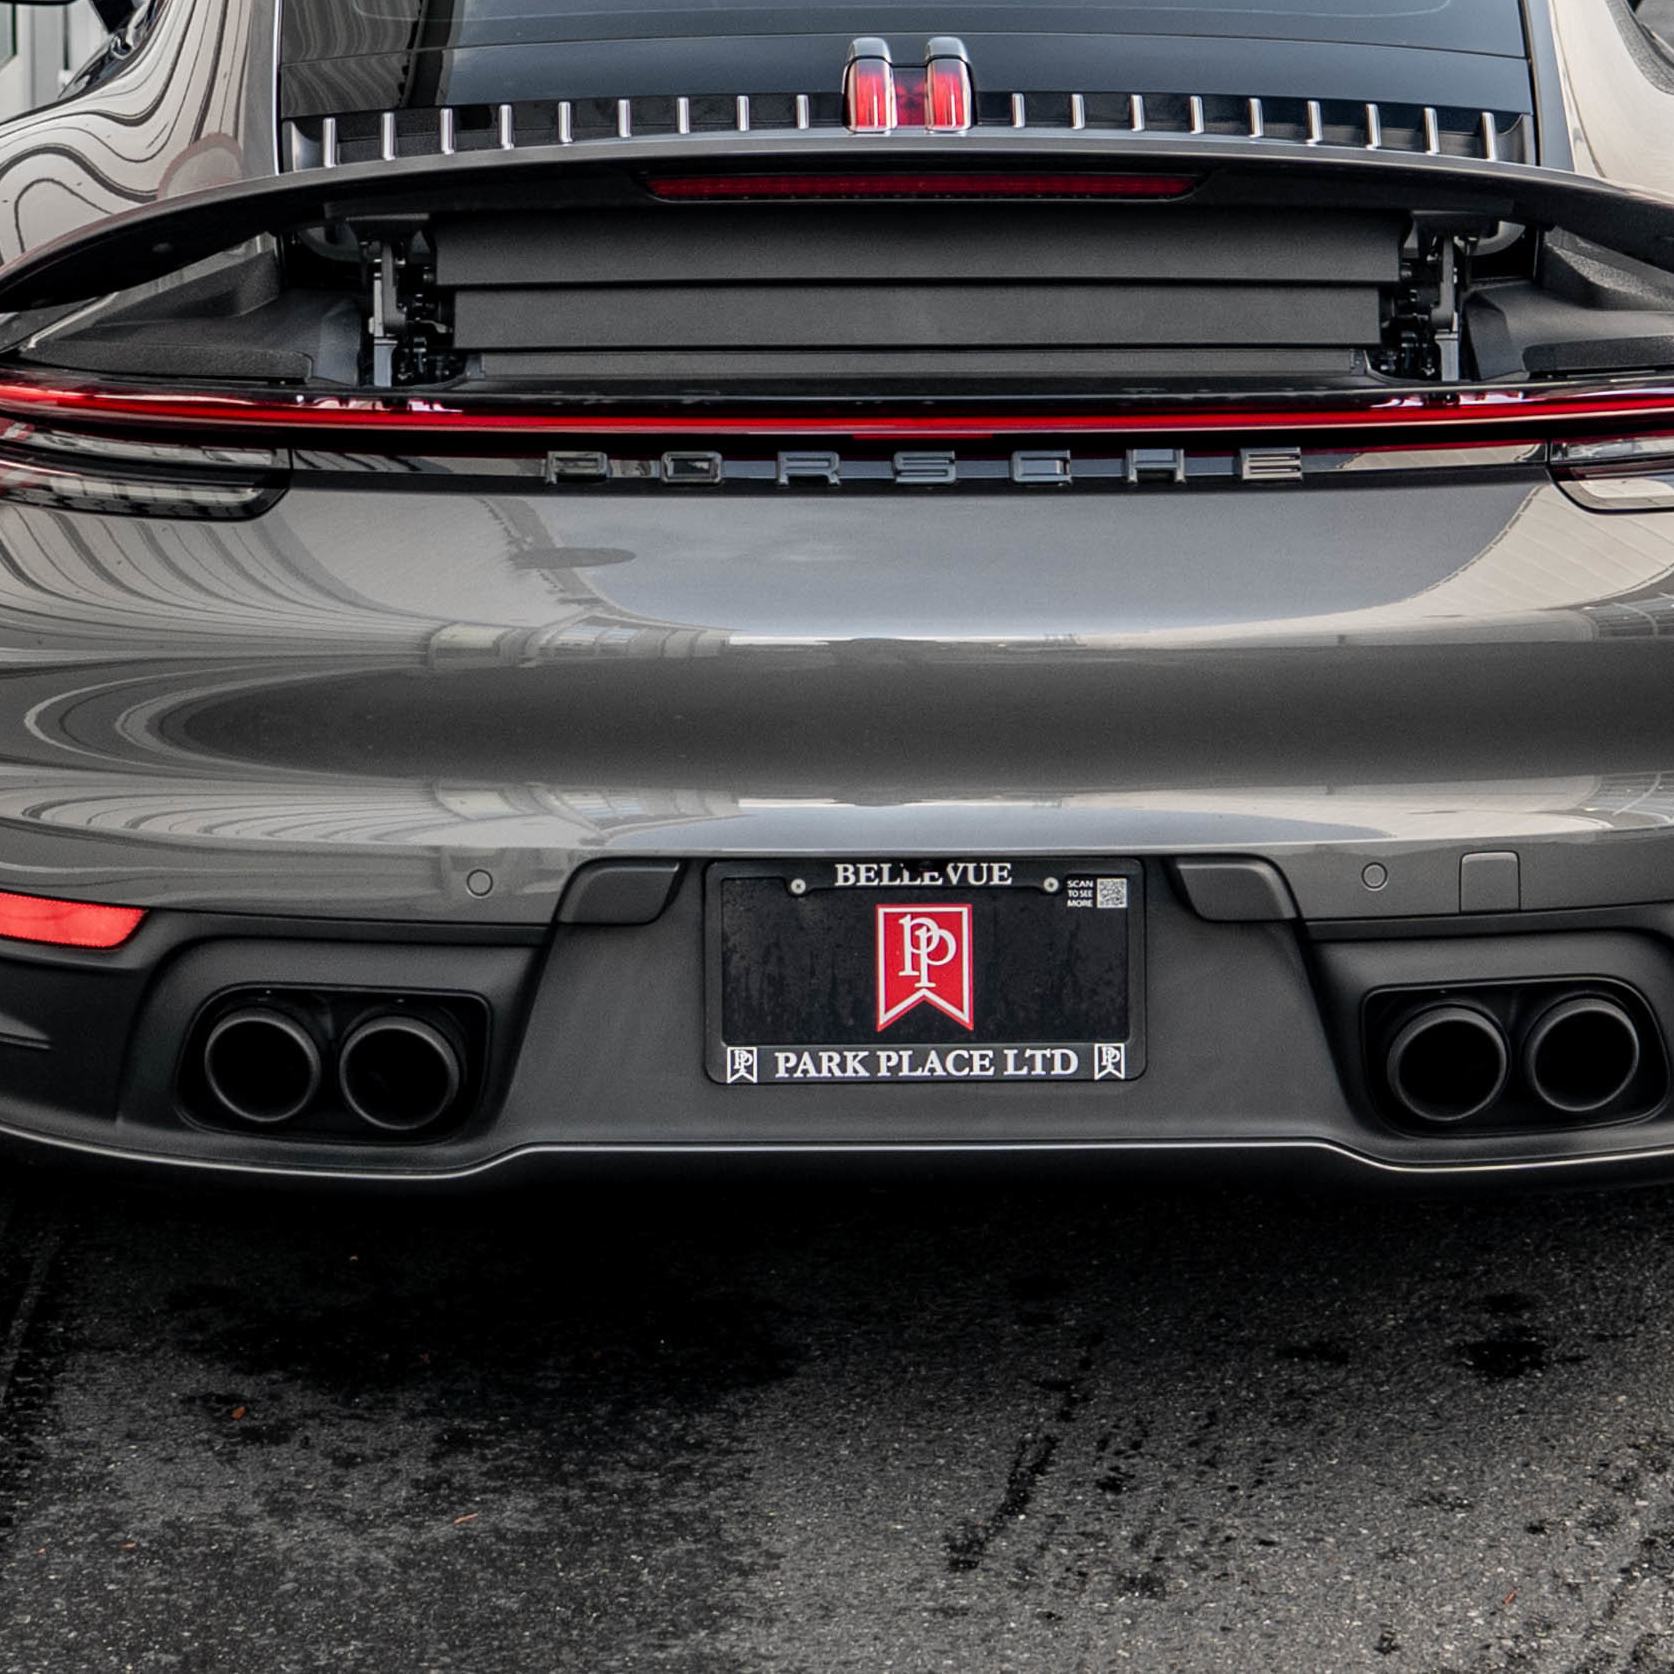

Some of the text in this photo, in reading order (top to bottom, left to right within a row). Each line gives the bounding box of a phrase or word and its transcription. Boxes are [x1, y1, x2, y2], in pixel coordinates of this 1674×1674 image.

[545, 446, 1305, 487] PORSCHE
[1066, 879, 1094, 888] SCAN
[1067, 889, 1079, 898] TO
[1066, 899, 1094, 908] MORE
[774, 1047, 1079, 1078] PARK PLACE LTD
